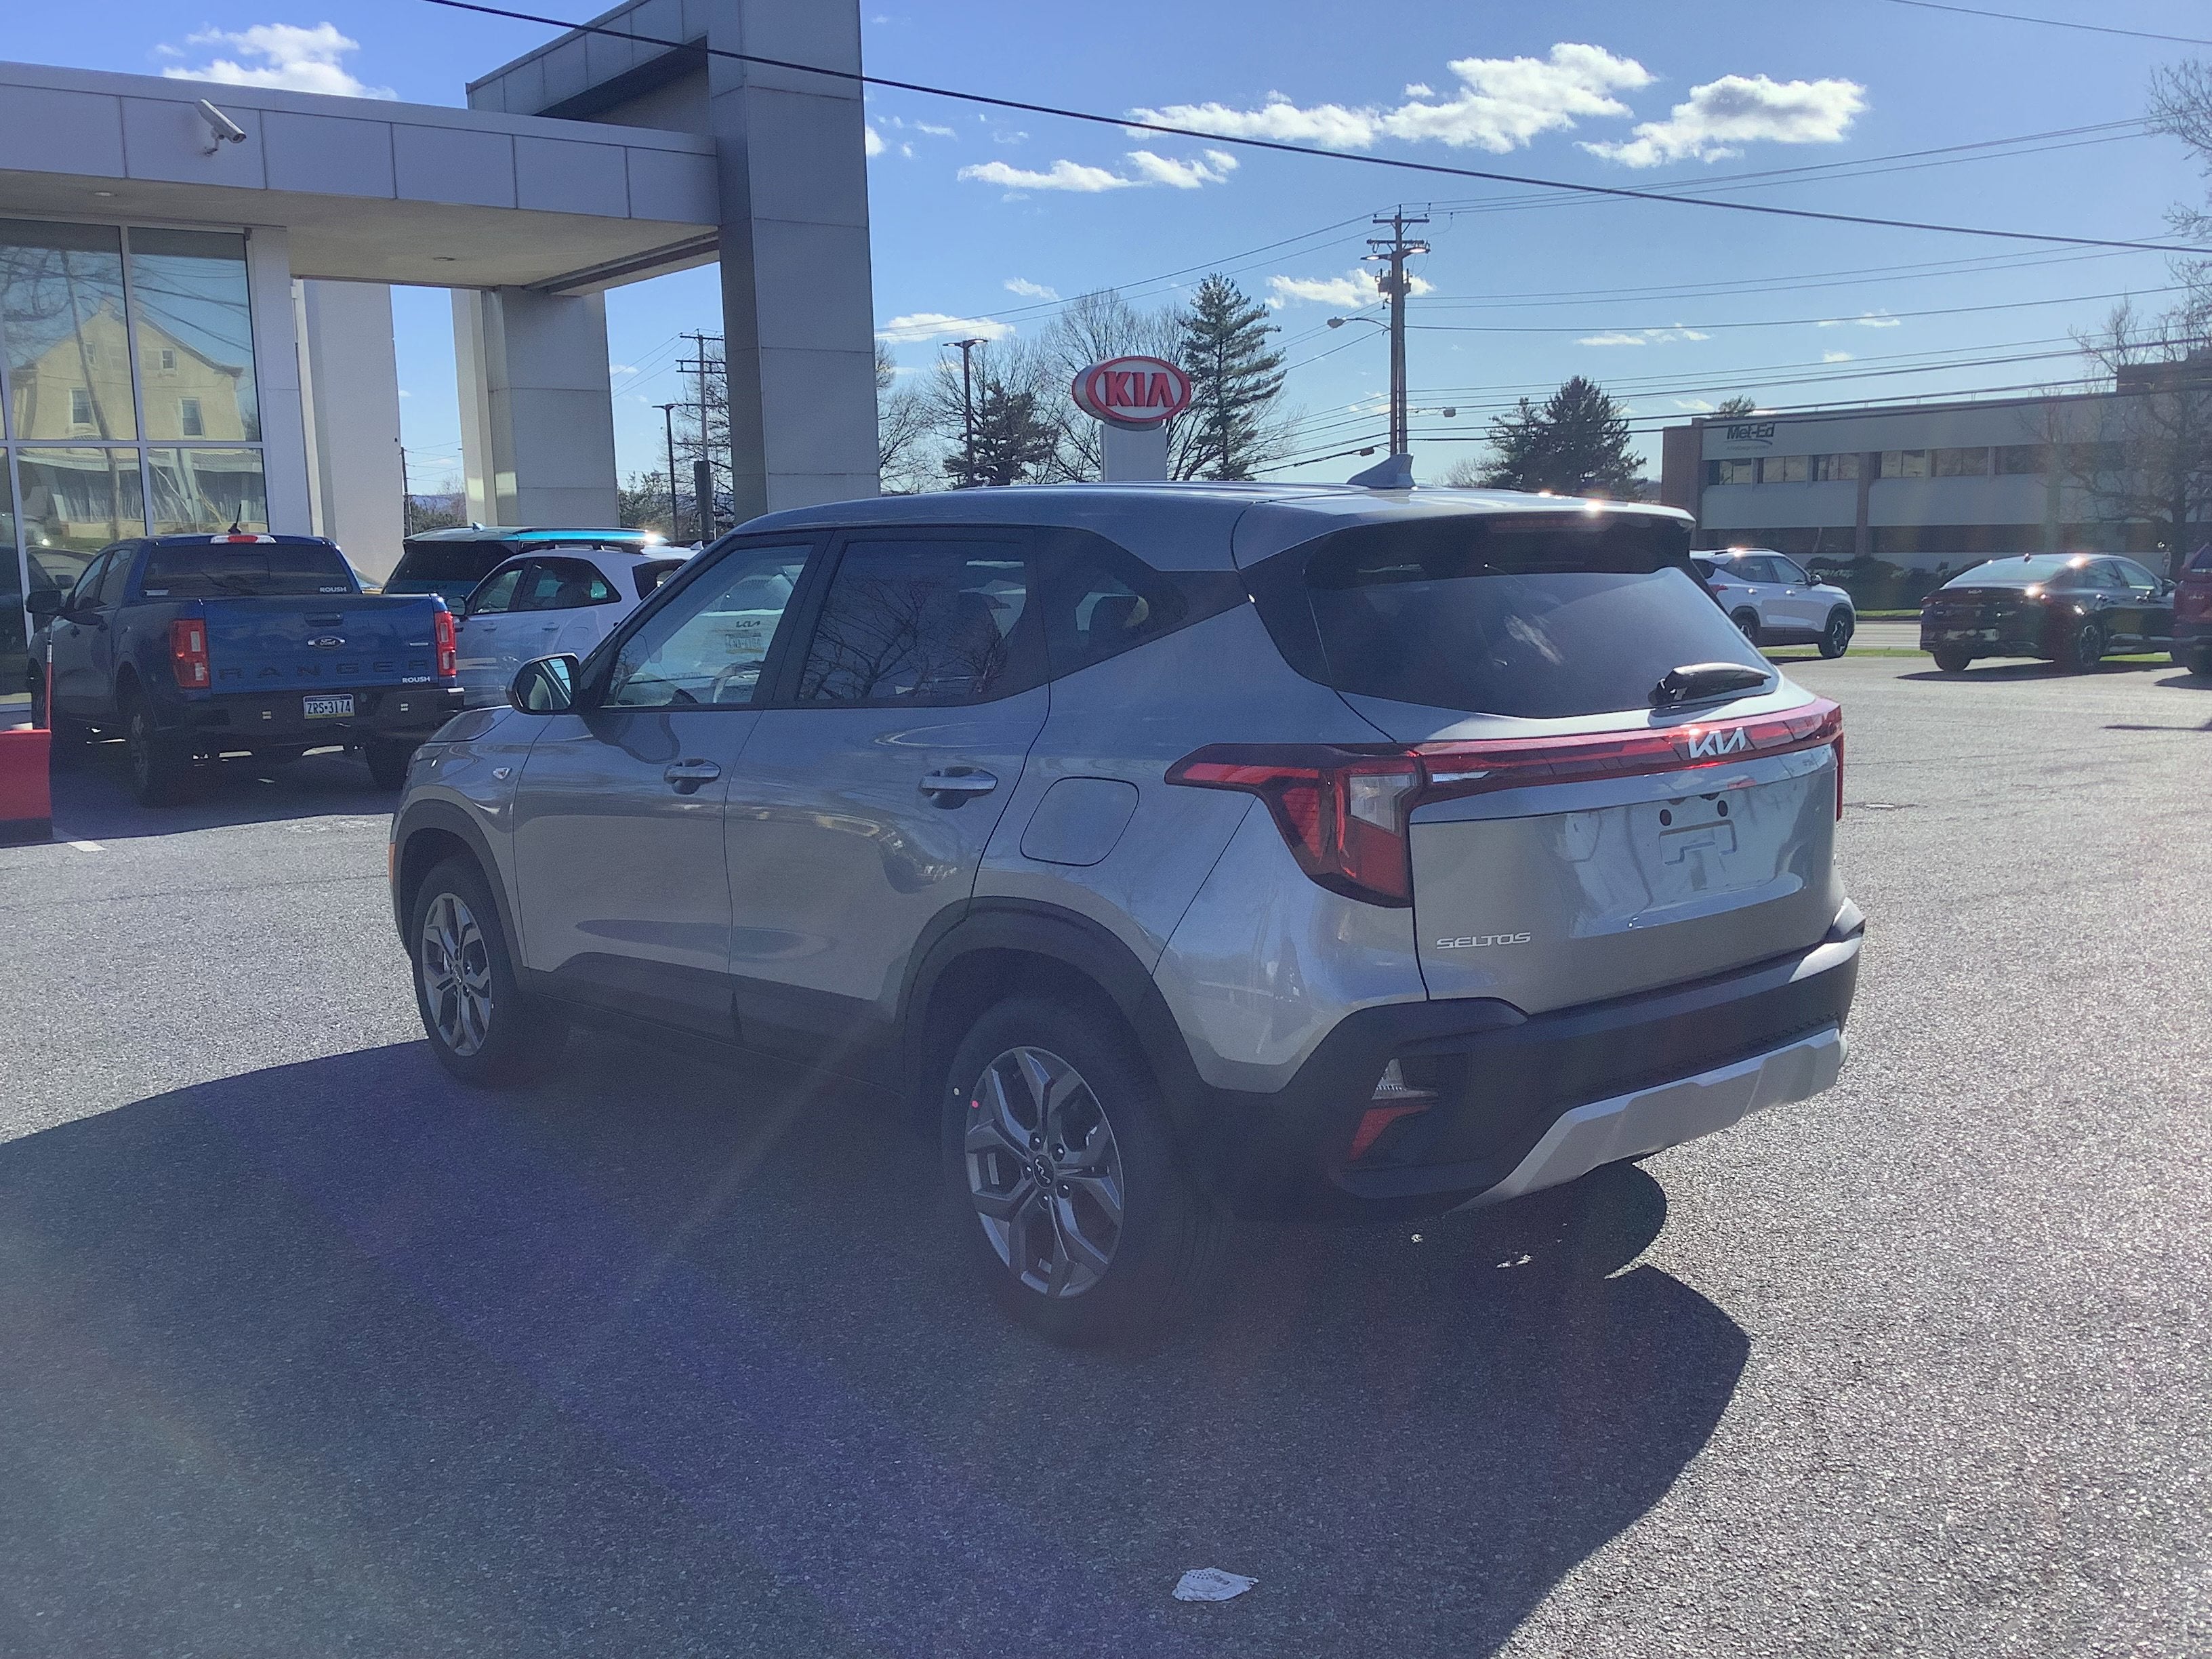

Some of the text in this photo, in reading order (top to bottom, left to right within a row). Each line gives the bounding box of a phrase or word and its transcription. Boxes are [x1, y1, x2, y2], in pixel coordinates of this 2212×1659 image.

[1103, 371, 1175, 407] KIA
[1727, 422, 1775, 439] Met-Ed
[218, 660, 428, 678] RANGER
[1688, 726, 1746, 758] KIA
[1436, 932, 1531, 949] SELTOS
